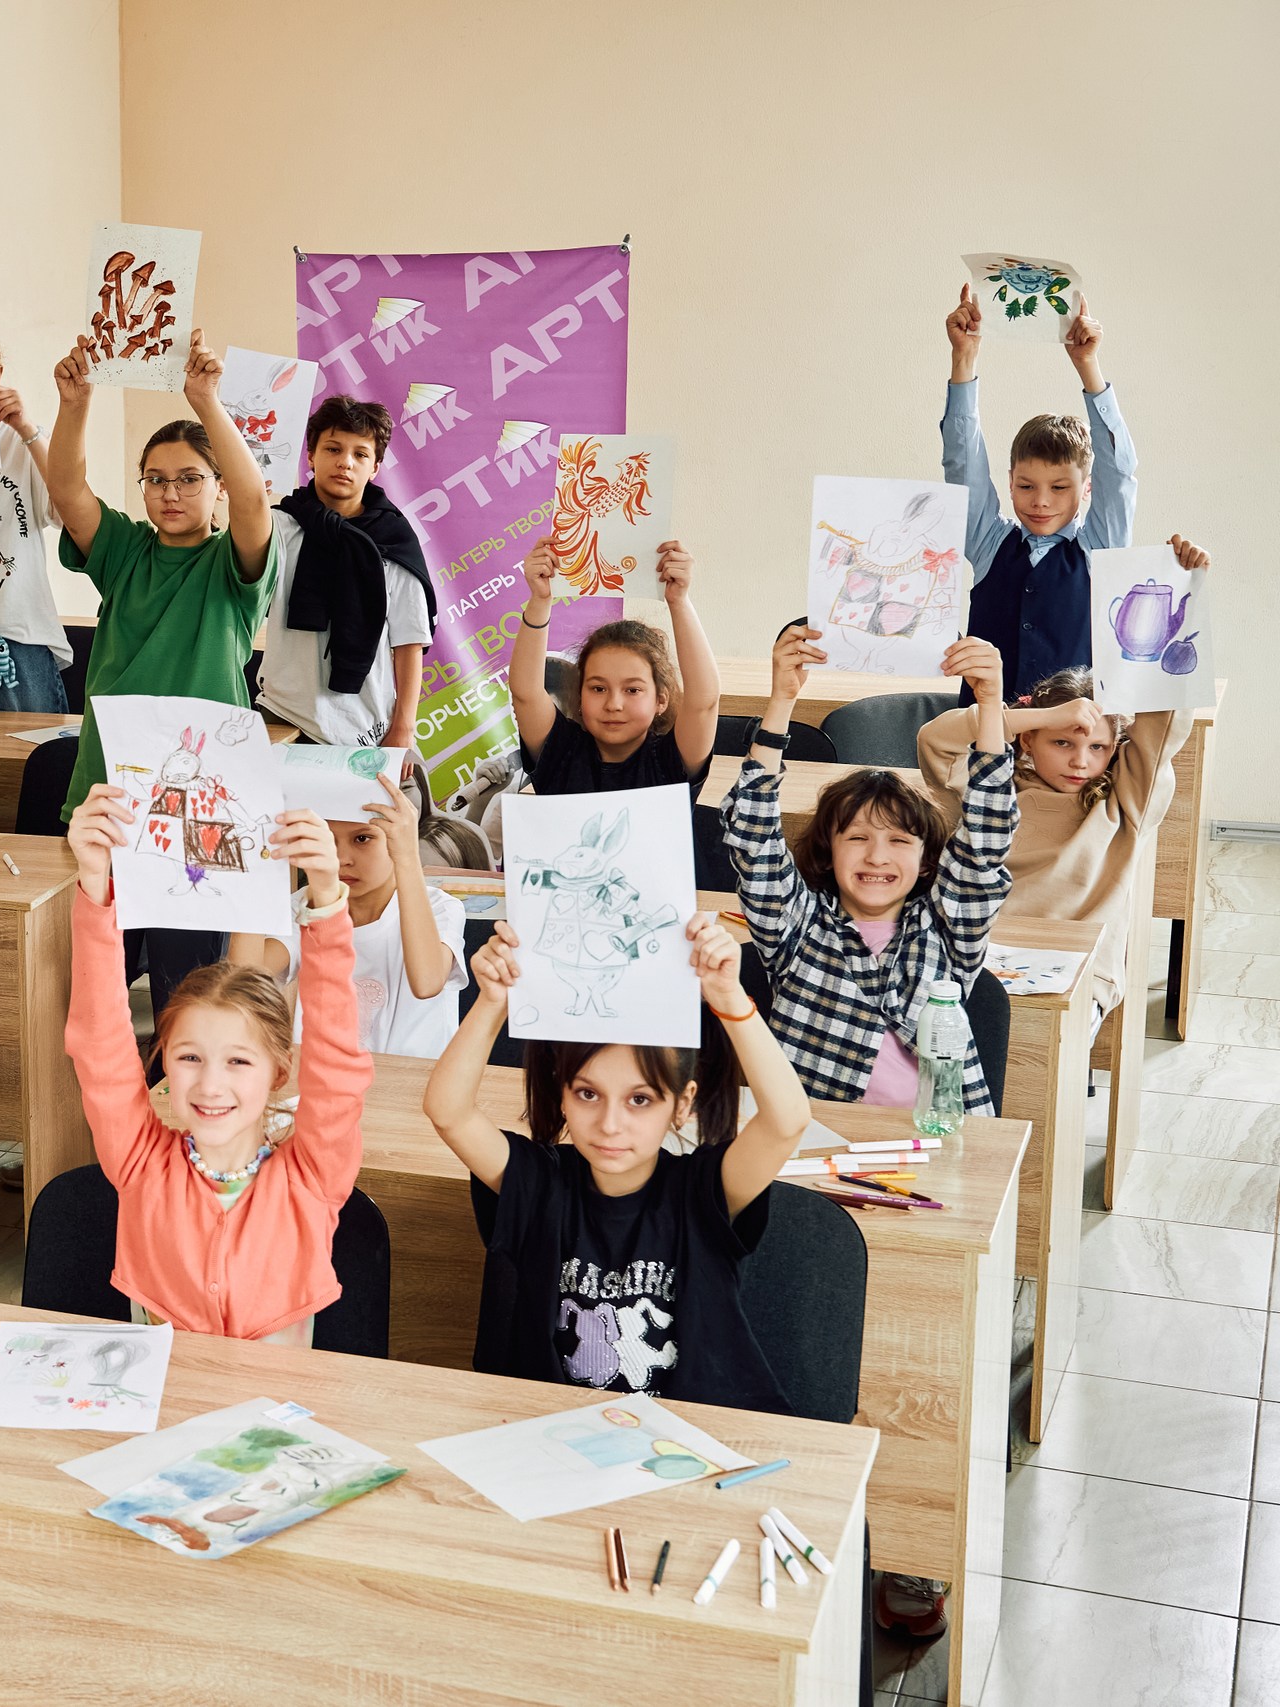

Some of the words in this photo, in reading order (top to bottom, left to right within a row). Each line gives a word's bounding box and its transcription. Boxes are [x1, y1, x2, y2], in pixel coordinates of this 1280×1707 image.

[436, 537, 506, 587] ЛАГЕРЬ
[504, 498, 555, 539] ТВОР
[446, 574, 516, 624] ЛАГЕРЬ
[414, 665, 510, 740] ОРЧЕСТ
